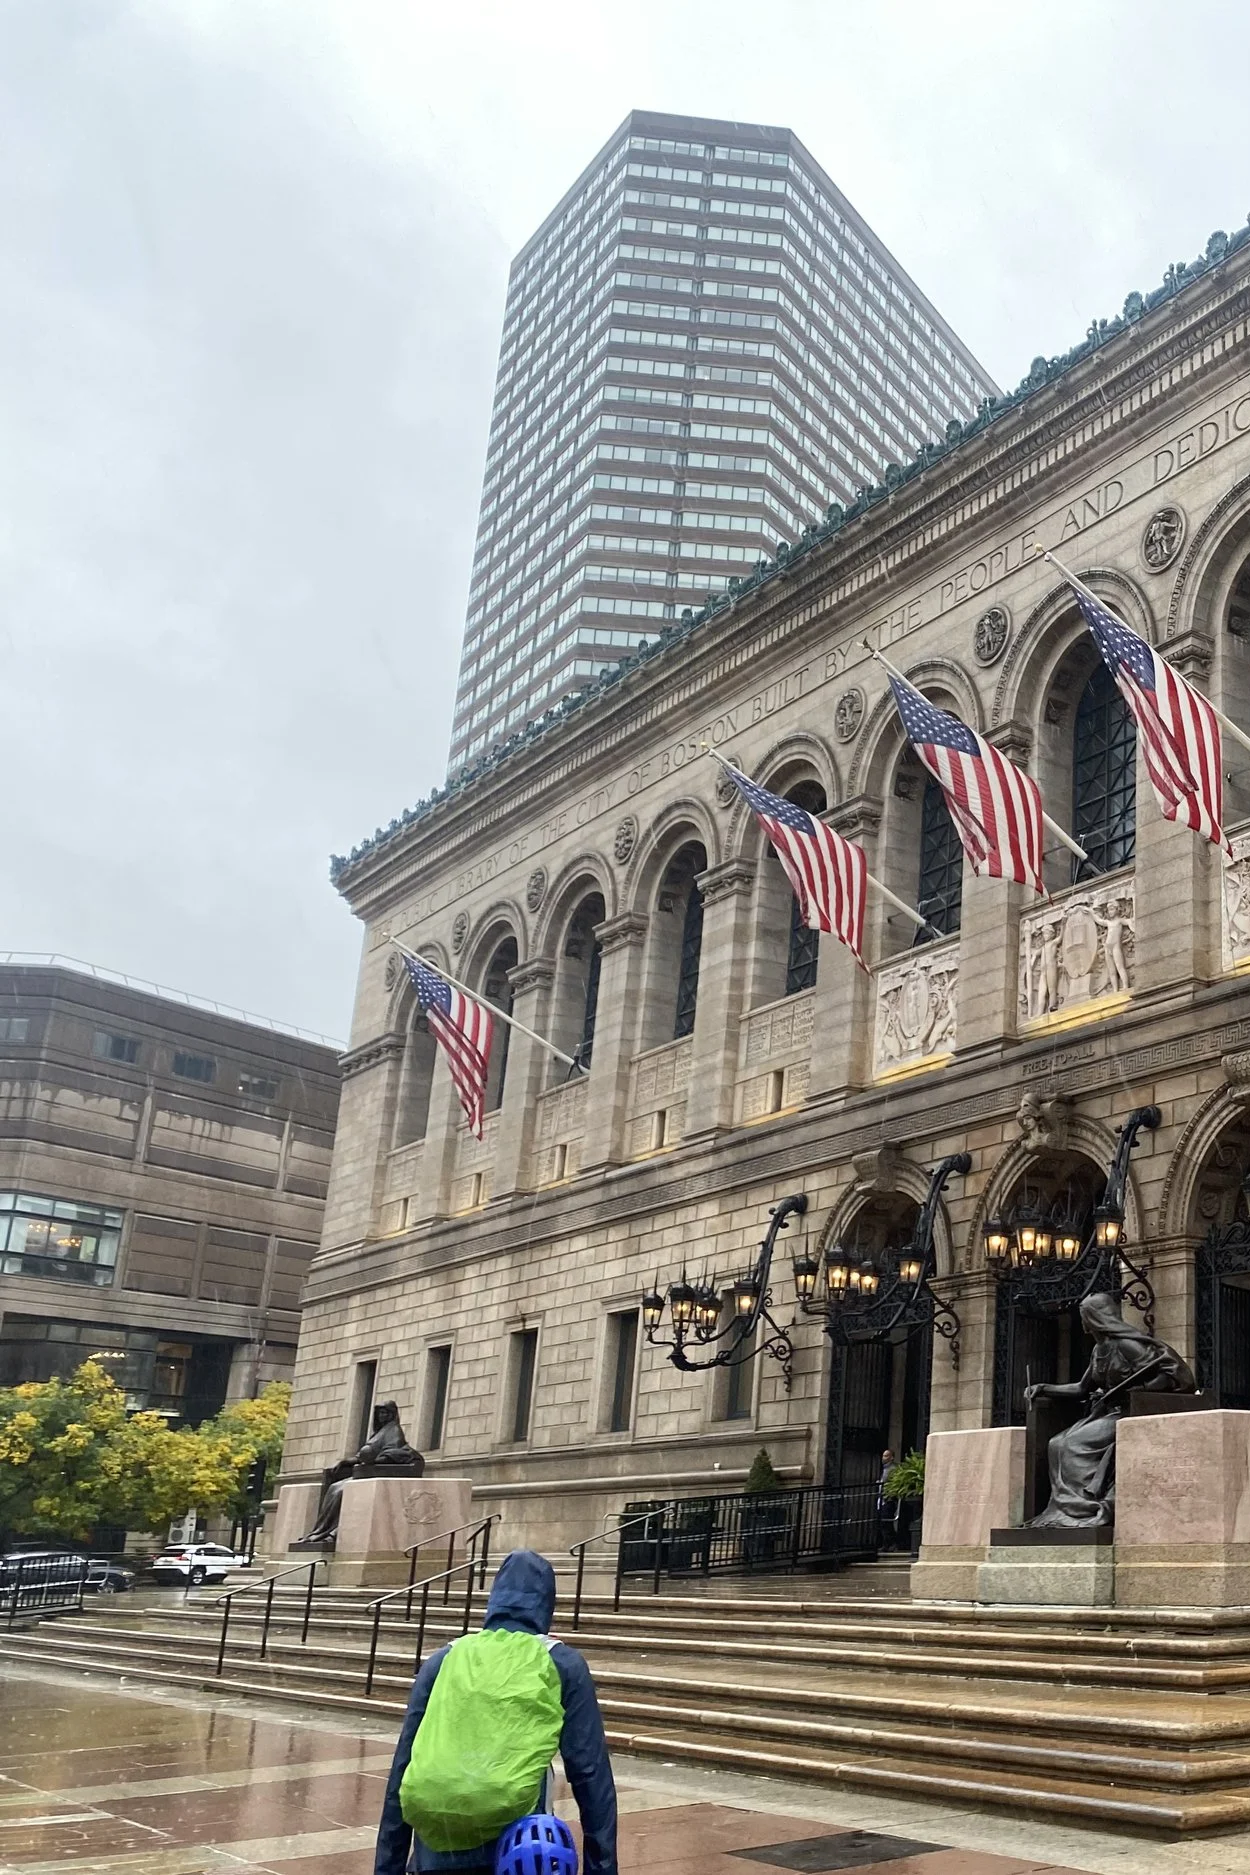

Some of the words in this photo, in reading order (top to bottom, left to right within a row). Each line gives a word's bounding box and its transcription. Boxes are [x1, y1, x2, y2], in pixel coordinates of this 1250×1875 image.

[509, 837, 529, 865] OF
[540, 813, 567, 846] THE
[576, 784, 616, 825] CITY
[627, 763, 651, 794] OF
[660, 709, 740, 777] BOSTON
[751, 668, 810, 723] BUILT
[825, 639, 854, 681] BY
[872, 600, 923, 649] THE
[940, 529, 1038, 613] PEOPLE
[1060, 480, 1124, 541] AND
